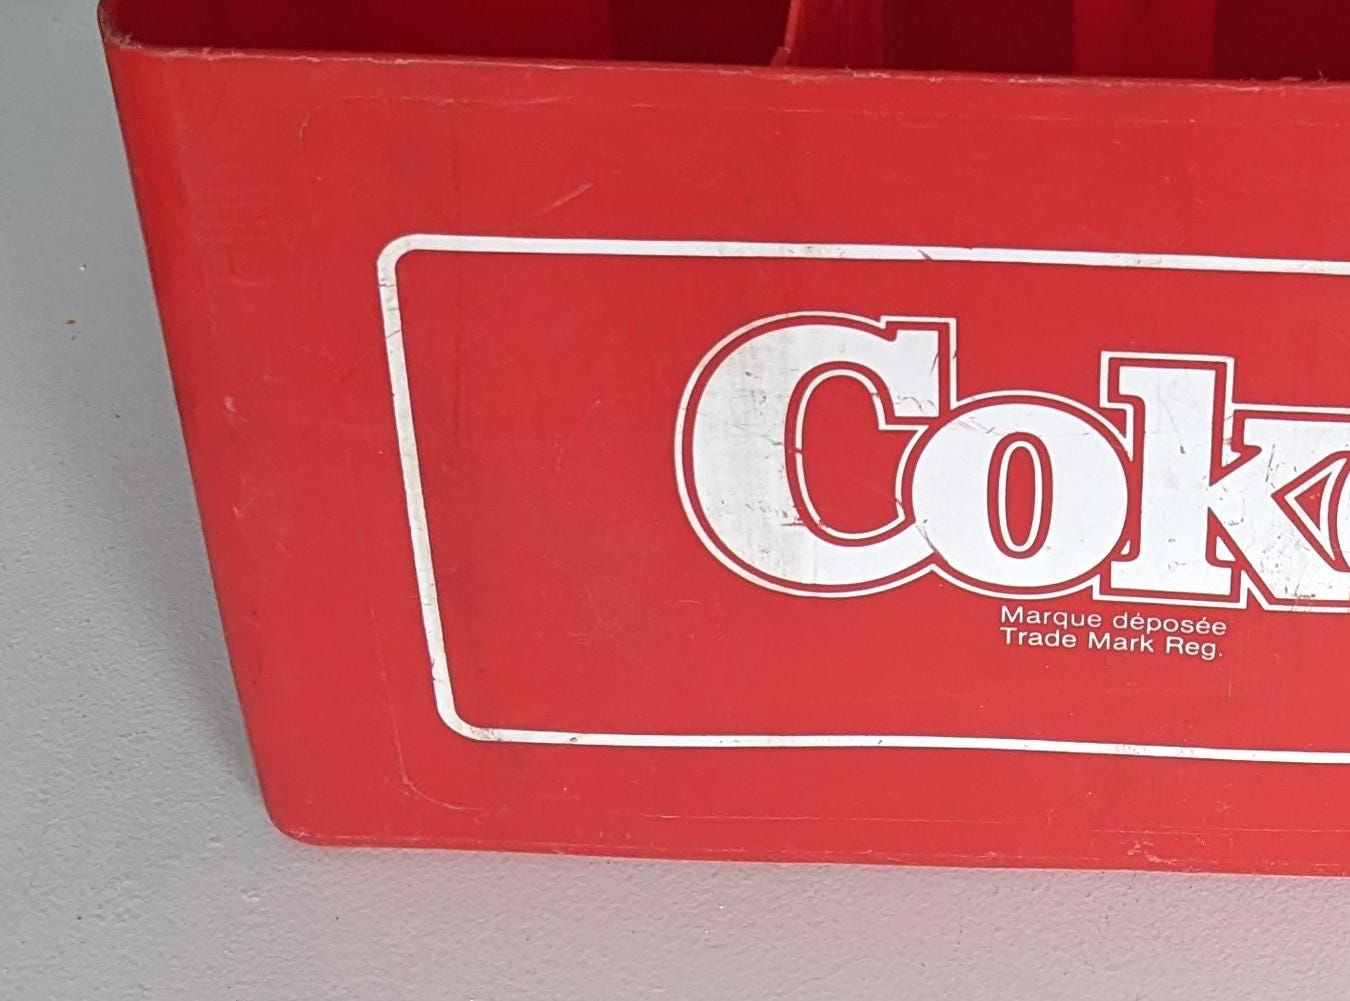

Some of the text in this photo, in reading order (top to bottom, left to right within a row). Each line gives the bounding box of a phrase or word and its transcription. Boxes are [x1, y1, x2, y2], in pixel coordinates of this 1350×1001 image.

[1000, 604, 1228, 636] Marque déposée
[999, 626, 1224, 661] Trade Mark Reg.
